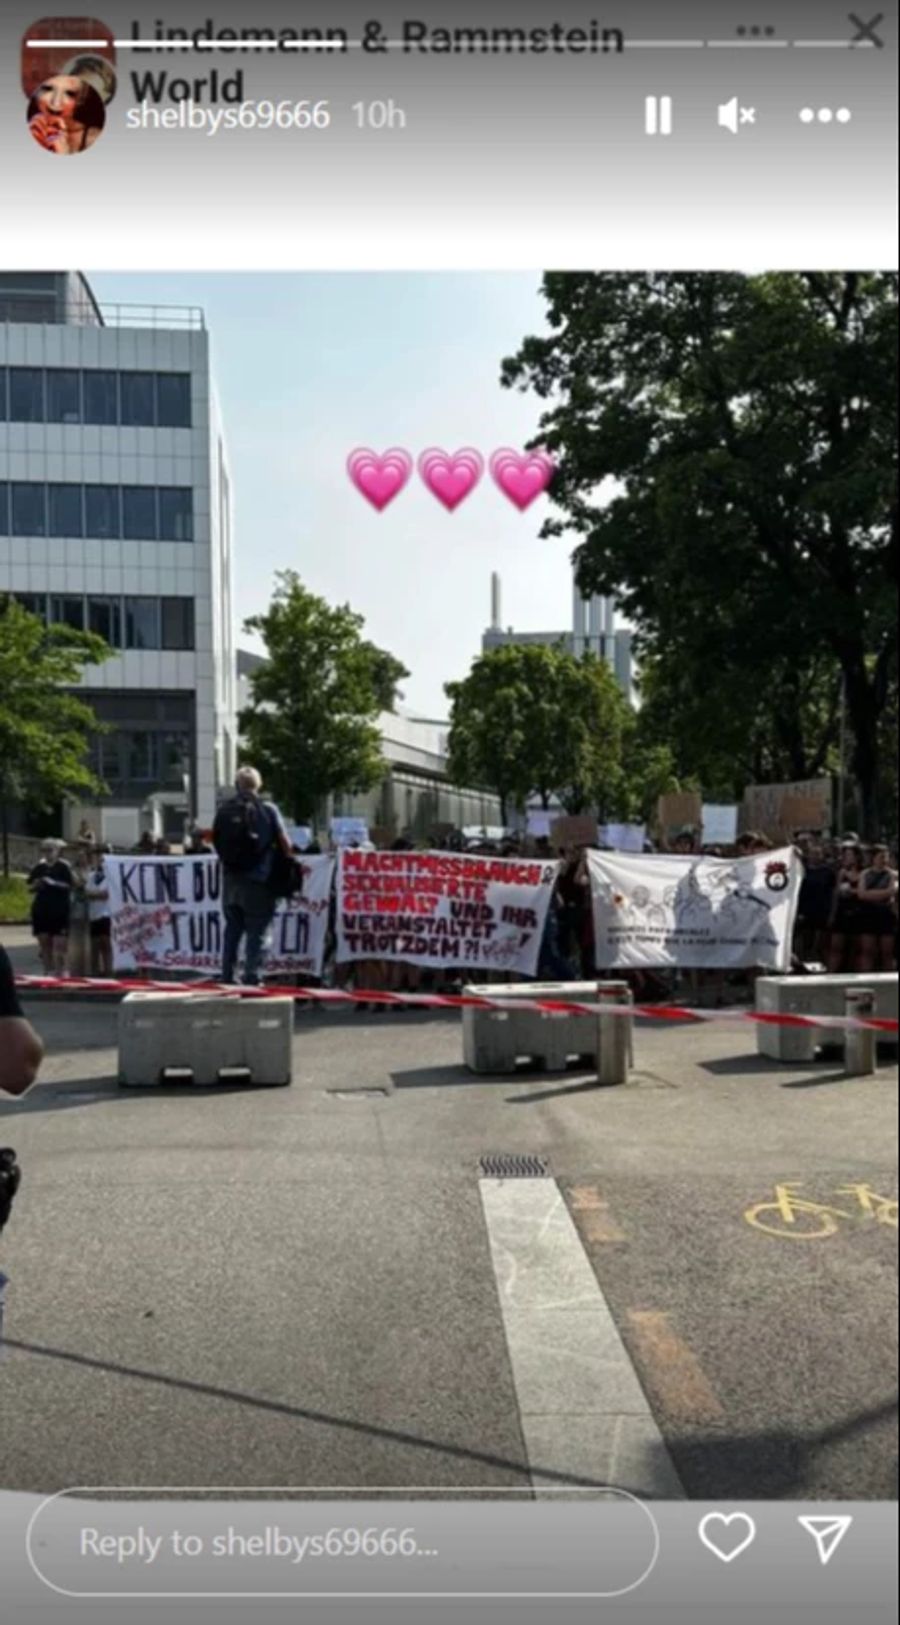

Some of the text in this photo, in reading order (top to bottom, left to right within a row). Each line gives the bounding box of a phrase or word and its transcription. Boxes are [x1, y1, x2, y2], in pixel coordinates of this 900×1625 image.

[342, 849, 542, 887] MACHTMISSBRAUCH
[342, 891, 438, 914] GEWALT
[450, 901, 494, 921] UND
[502, 905, 538, 928] IHR
[342, 912, 498, 939] VERANSTALTET
[343, 932, 459, 958] TROTZDEM
